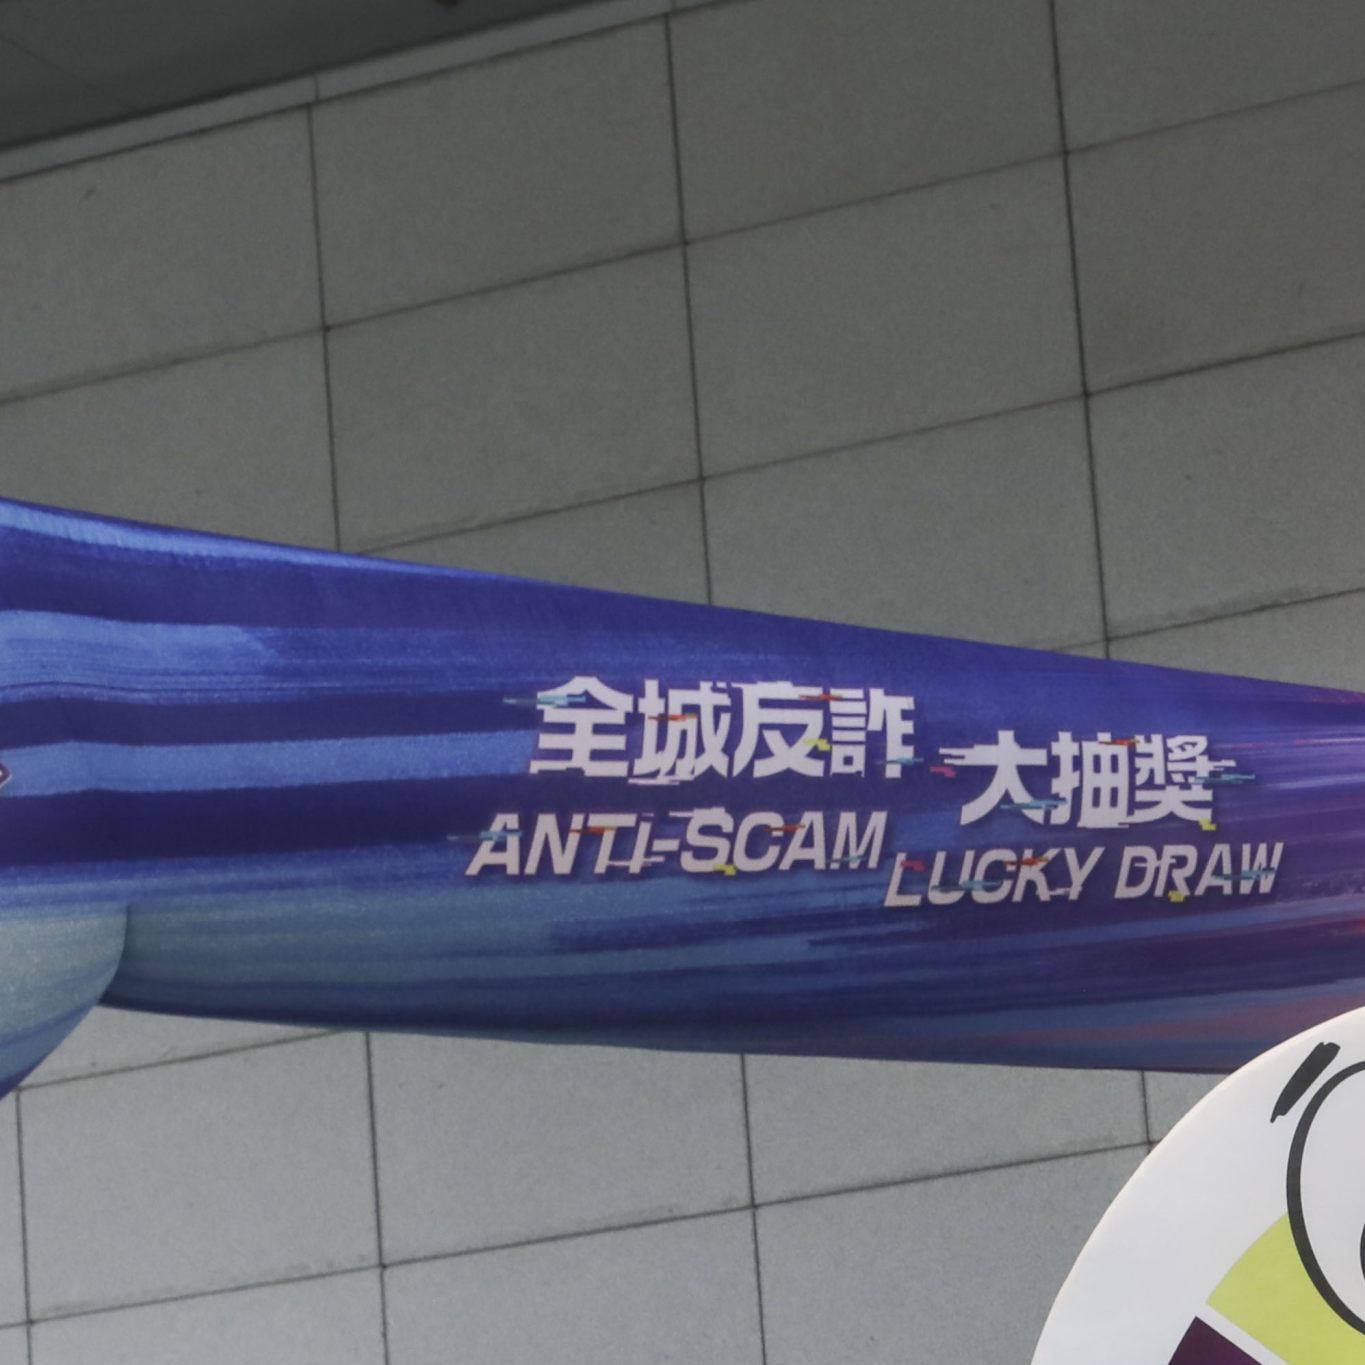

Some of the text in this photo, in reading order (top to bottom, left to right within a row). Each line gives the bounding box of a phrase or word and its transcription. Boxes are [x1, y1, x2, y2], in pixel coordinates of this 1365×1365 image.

[526, 675, 1236, 829] 全城反詐 大抽獎
[465, 806, 1283, 906] ANTI-SCAM LUCKY DRAW
